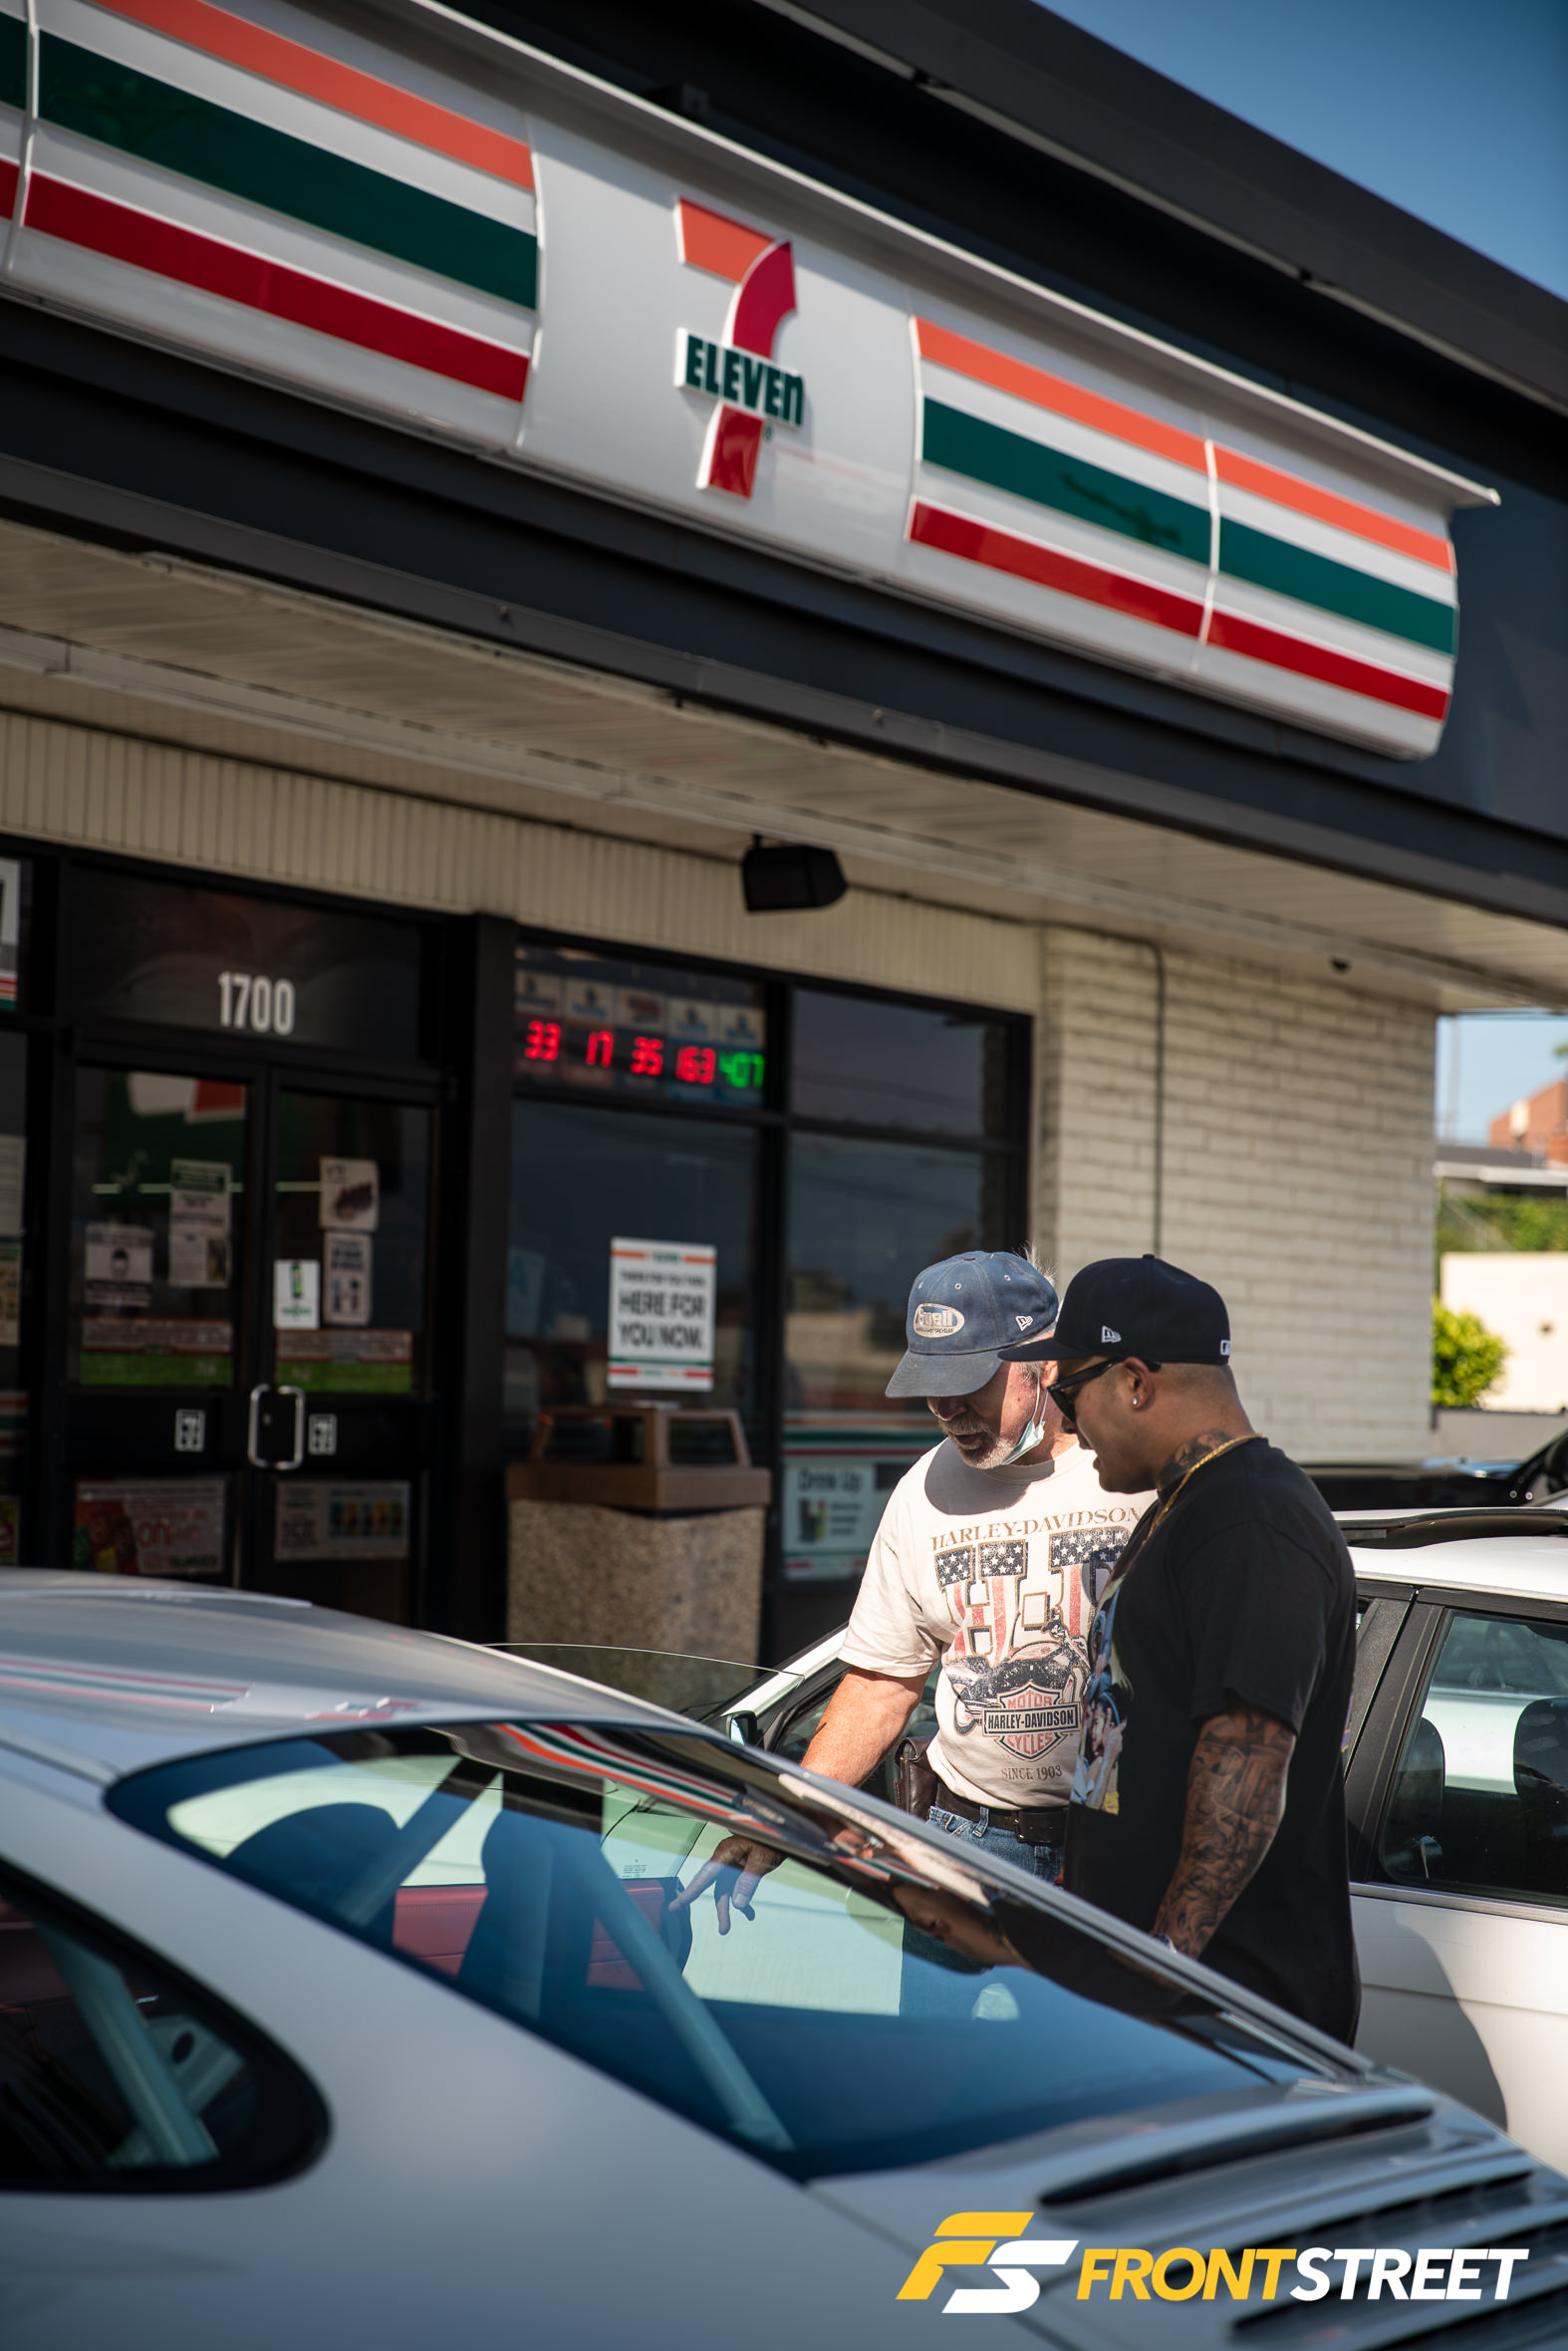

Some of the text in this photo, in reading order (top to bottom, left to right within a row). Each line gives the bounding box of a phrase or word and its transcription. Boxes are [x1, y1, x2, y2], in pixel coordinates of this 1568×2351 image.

[218, 971, 295, 1036] 1700
[525, 1020, 561, 1061] 33
[619, 1290, 705, 1318] HERE FOR
[618, 1322, 653, 1347] YOU
[1007, 1690, 1053, 1709] MOTOR
[987, 1708, 1074, 1729] HARLEY-DAVIDSON
[1007, 1732, 1054, 1755] CYCLES
[1001, 1765, 1063, 1781] SINCE 1903
